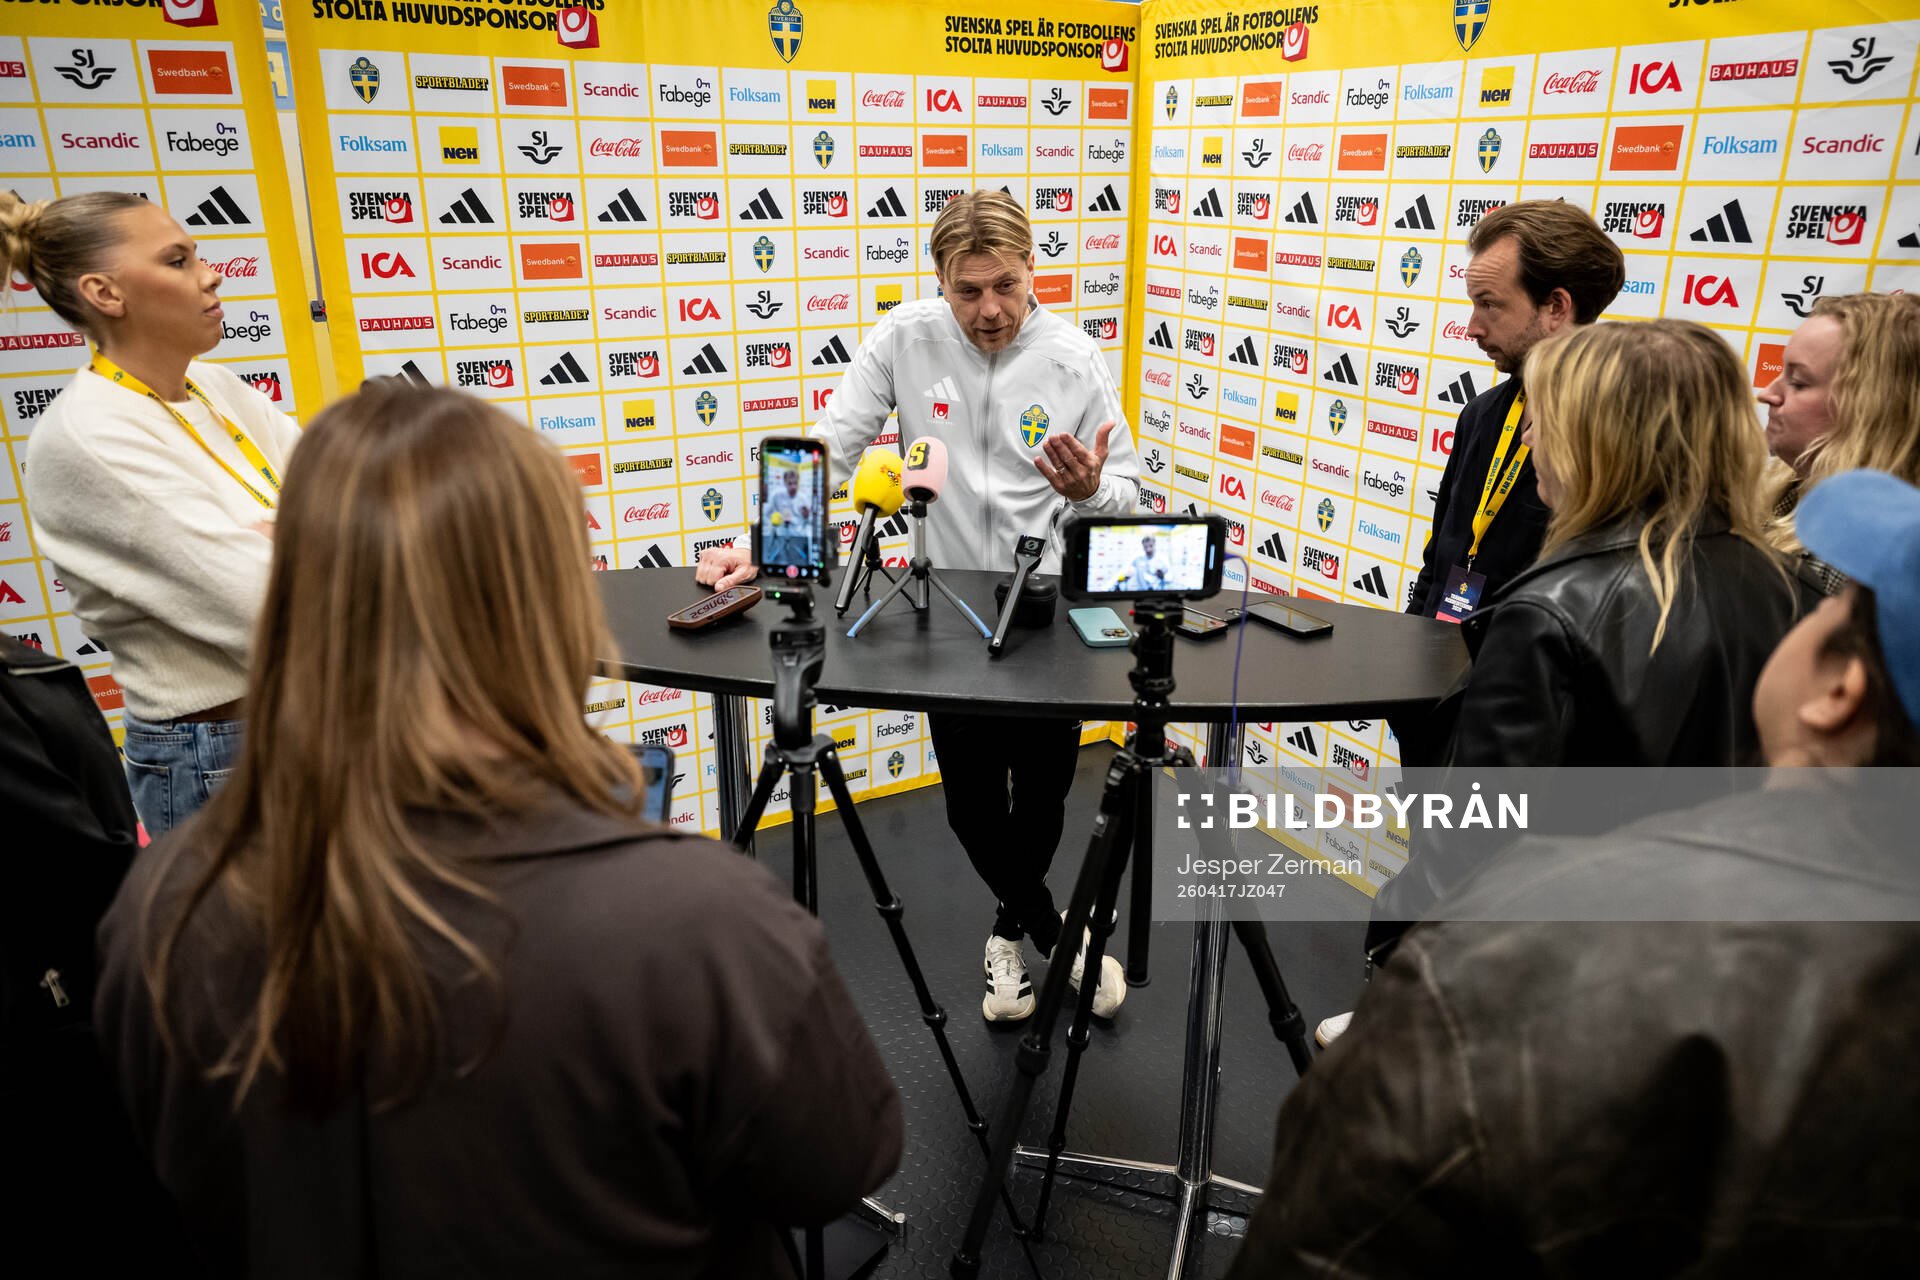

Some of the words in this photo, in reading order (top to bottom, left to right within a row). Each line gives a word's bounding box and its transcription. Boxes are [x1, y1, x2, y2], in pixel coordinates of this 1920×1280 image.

[313, 0, 387, 21] STOLTA
[393, 5, 558, 31] HUVUDSPONSOR
[1155, 20, 1197, 39] SVENSKA
[1200, 18, 1222, 35] SPEL
[1225, 12, 1239, 31] ÄR
[1243, 6, 1318, 29] FOTBOLLENS
[945, 16, 1001, 35] SVENSKA
[1006, 19, 1034, 38] SPEL
[1037, 18, 1053, 38] ÄR
[1058, 22, 1135, 42] FOTBOLLENS
[945, 37, 992, 54] STOLTA
[996, 40, 1102, 59] HUVUDSPONSOR
[1155, 40, 1187, 59] STOLTA
[1191, 31, 1283, 56] HUVUDSPONSOR
[1851, 37, 1876, 58] SJ
[72, 49, 95, 68] SJ
[157, 68, 208, 77] Swedbank
[1710, 59, 1799, 81] BAUHAUS
[415, 76, 488, 91] SPORTBLADET
[1543, 70, 1602, 95] Coca-Cola
[1629, 61, 1682, 94] ICA
[509, 82, 549, 91] Swedbank
[584, 83, 639, 97] Scandic
[1051, 87, 1062, 100] SJ
[1404, 85, 1453, 100] Folksam
[660, 84, 711, 107] Fabege
[729, 87, 781, 103] Folksam
[927, 89, 962, 112] ICA
[978, 96, 1026, 107] BAUHAUS
[1291, 91, 1330, 104] Scandic
[1346, 88, 1389, 110] Fabege
[61, 133, 139, 149] Scandic
[167, 132, 239, 156] Fabege
[340, 136, 407, 152] Folksam
[532, 131, 547, 146] SJ
[1253, 139, 1263, 151] SJ
[1703, 136, 1777, 154] Folksam
[1803, 134, 1885, 153] Scandic
[590, 138, 641, 157] Coca-Cola
[666, 145, 702, 153] Swedbank
[729, 144, 787, 155] SPORTBLADET
[859, 146, 912, 157] BAUHAUS
[981, 144, 1023, 157] Folksam
[1036, 146, 1075, 158] Scandic
[1089, 145, 1125, 163] Fabege
[1154, 146, 1184, 157] Folksam
[1397, 146, 1450, 157] SPORTBLADET
[1529, 143, 1598, 158] BAUHAUS
[1617, 143, 1660, 154] Swedbank
[349, 192, 411, 206] SVENSKA
[518, 192, 574, 206] SVENSKA
[669, 192, 719, 205] SVENSKA
[803, 191, 848, 203] SVENSKA
[1035, 188, 1073, 199] SVENSKA
[1155, 189, 1180, 201] SVENSKA
[1238, 192, 1270, 203] SVENSKA
[803, 203, 827, 215] SPEL
[1035, 199, 1055, 210] SPEL
[1155, 199, 1167, 210] SPEL
[1237, 204, 1252, 215] SPEL
[1337, 197, 1378, 209] SVENSKA
[1605, 202, 1665, 218] SVENSKA
[351, 206, 384, 220] SPEL
[519, 206, 549, 219] SPEL
[669, 204, 696, 217] SPEL
[1335, 208, 1356, 221] SPEL
[1790, 205, 1867, 223] SVENSKA
[1603, 217, 1632, 233] SPEL
[1786, 222, 1825, 240] SPEL
[1048, 231, 1059, 243] SJ
[1154, 235, 1177, 256] ICA
[1189, 242, 1222, 256] Scandic
[667, 252, 726, 264] SPORTBLADET
[804, 247, 850, 259] Scandic
[867, 245, 909, 263] Fabege
[1275, 253, 1321, 266] BAUHAUS
[361, 252, 416, 279] ICA
[442, 256, 502, 270] Scandic
[526, 258, 565, 266] Swedbank
[595, 254, 658, 267] BAUHAUS
[1327, 256, 1375, 271] SPORTBLADET
[1084, 281, 1118, 295] Fabege
[1147, 285, 1180, 298] BAUHAUS
[1683, 274, 1739, 307] ICA
[1803, 276, 1824, 294] SJ
[758, 290, 770, 304] SJ
[1188, 288, 1218, 309] Fabege
[1227, 296, 1268, 310] SPORTBLADET
[524, 310, 589, 323] SPORTBLADET
[604, 306, 657, 320] Scandic
[679, 298, 721, 321] ICA
[1277, 302, 1310, 318] Scandic
[1397, 307, 1408, 321] SJ
[450, 313, 507, 333] Fabege
[1327, 304, 1362, 330] ICA
[360, 317, 434, 332] BAUHAUS
[1186, 329, 1214, 341] SVENSKA
[746, 342, 791, 355] SVENSKA
[1185, 339, 1200, 351] SPEL
[1275, 345, 1308, 357] SVENSKA
[608, 351, 658, 365] SVENSKA
[747, 355, 770, 367] SPEL
[1274, 356, 1291, 368] SPEL
[457, 361, 513, 374] SVENSKA
[610, 364, 636, 376] SPEL
[1377, 362, 1419, 377] SVENSKA
[458, 374, 487, 386] SPEL
[1193, 374, 1202, 386] SJ
[1376, 374, 1396, 389] SPEL
[814, 388, 834, 410] IC
[1223, 388, 1257, 407] Folksam
[744, 398, 798, 412] BAUHAUS
[540, 416, 596, 430] Folksam
[1144, 411, 1170, 432] Fabege
[1179, 422, 1211, 440] Scandic
[1368, 421, 1417, 440] BAUHAUS
[1432, 429, 1453, 455] IC
[686, 451, 734, 466] Scandic
[1151, 450, 1159, 461] SJ
[1262, 447, 1303, 465] SPORTBLADET
[614, 460, 672, 473] SPORTBLADET
[1312, 459, 1349, 478] Scandic
[1220, 474, 1246, 500] ICA
[1364, 471, 1404, 497] Fabege
[1140, 488, 1166, 502] SVENSKA
[1139, 498, 1153, 510] SPEL
[1358, 520, 1401, 544] Folksam
[1304, 546, 1340, 566] SVENSKA
[1302, 557, 1321, 572] SPEL
[877, 720, 914, 738] Fabege
[1252, 741, 1261, 753] SJ
[1332, 754, 1350, 771] SPEL
[1334, 744, 1370, 767] SVENSKA
[1280, 765, 1316, 794] Folksam
[1325, 832, 1361, 862] Fabege
